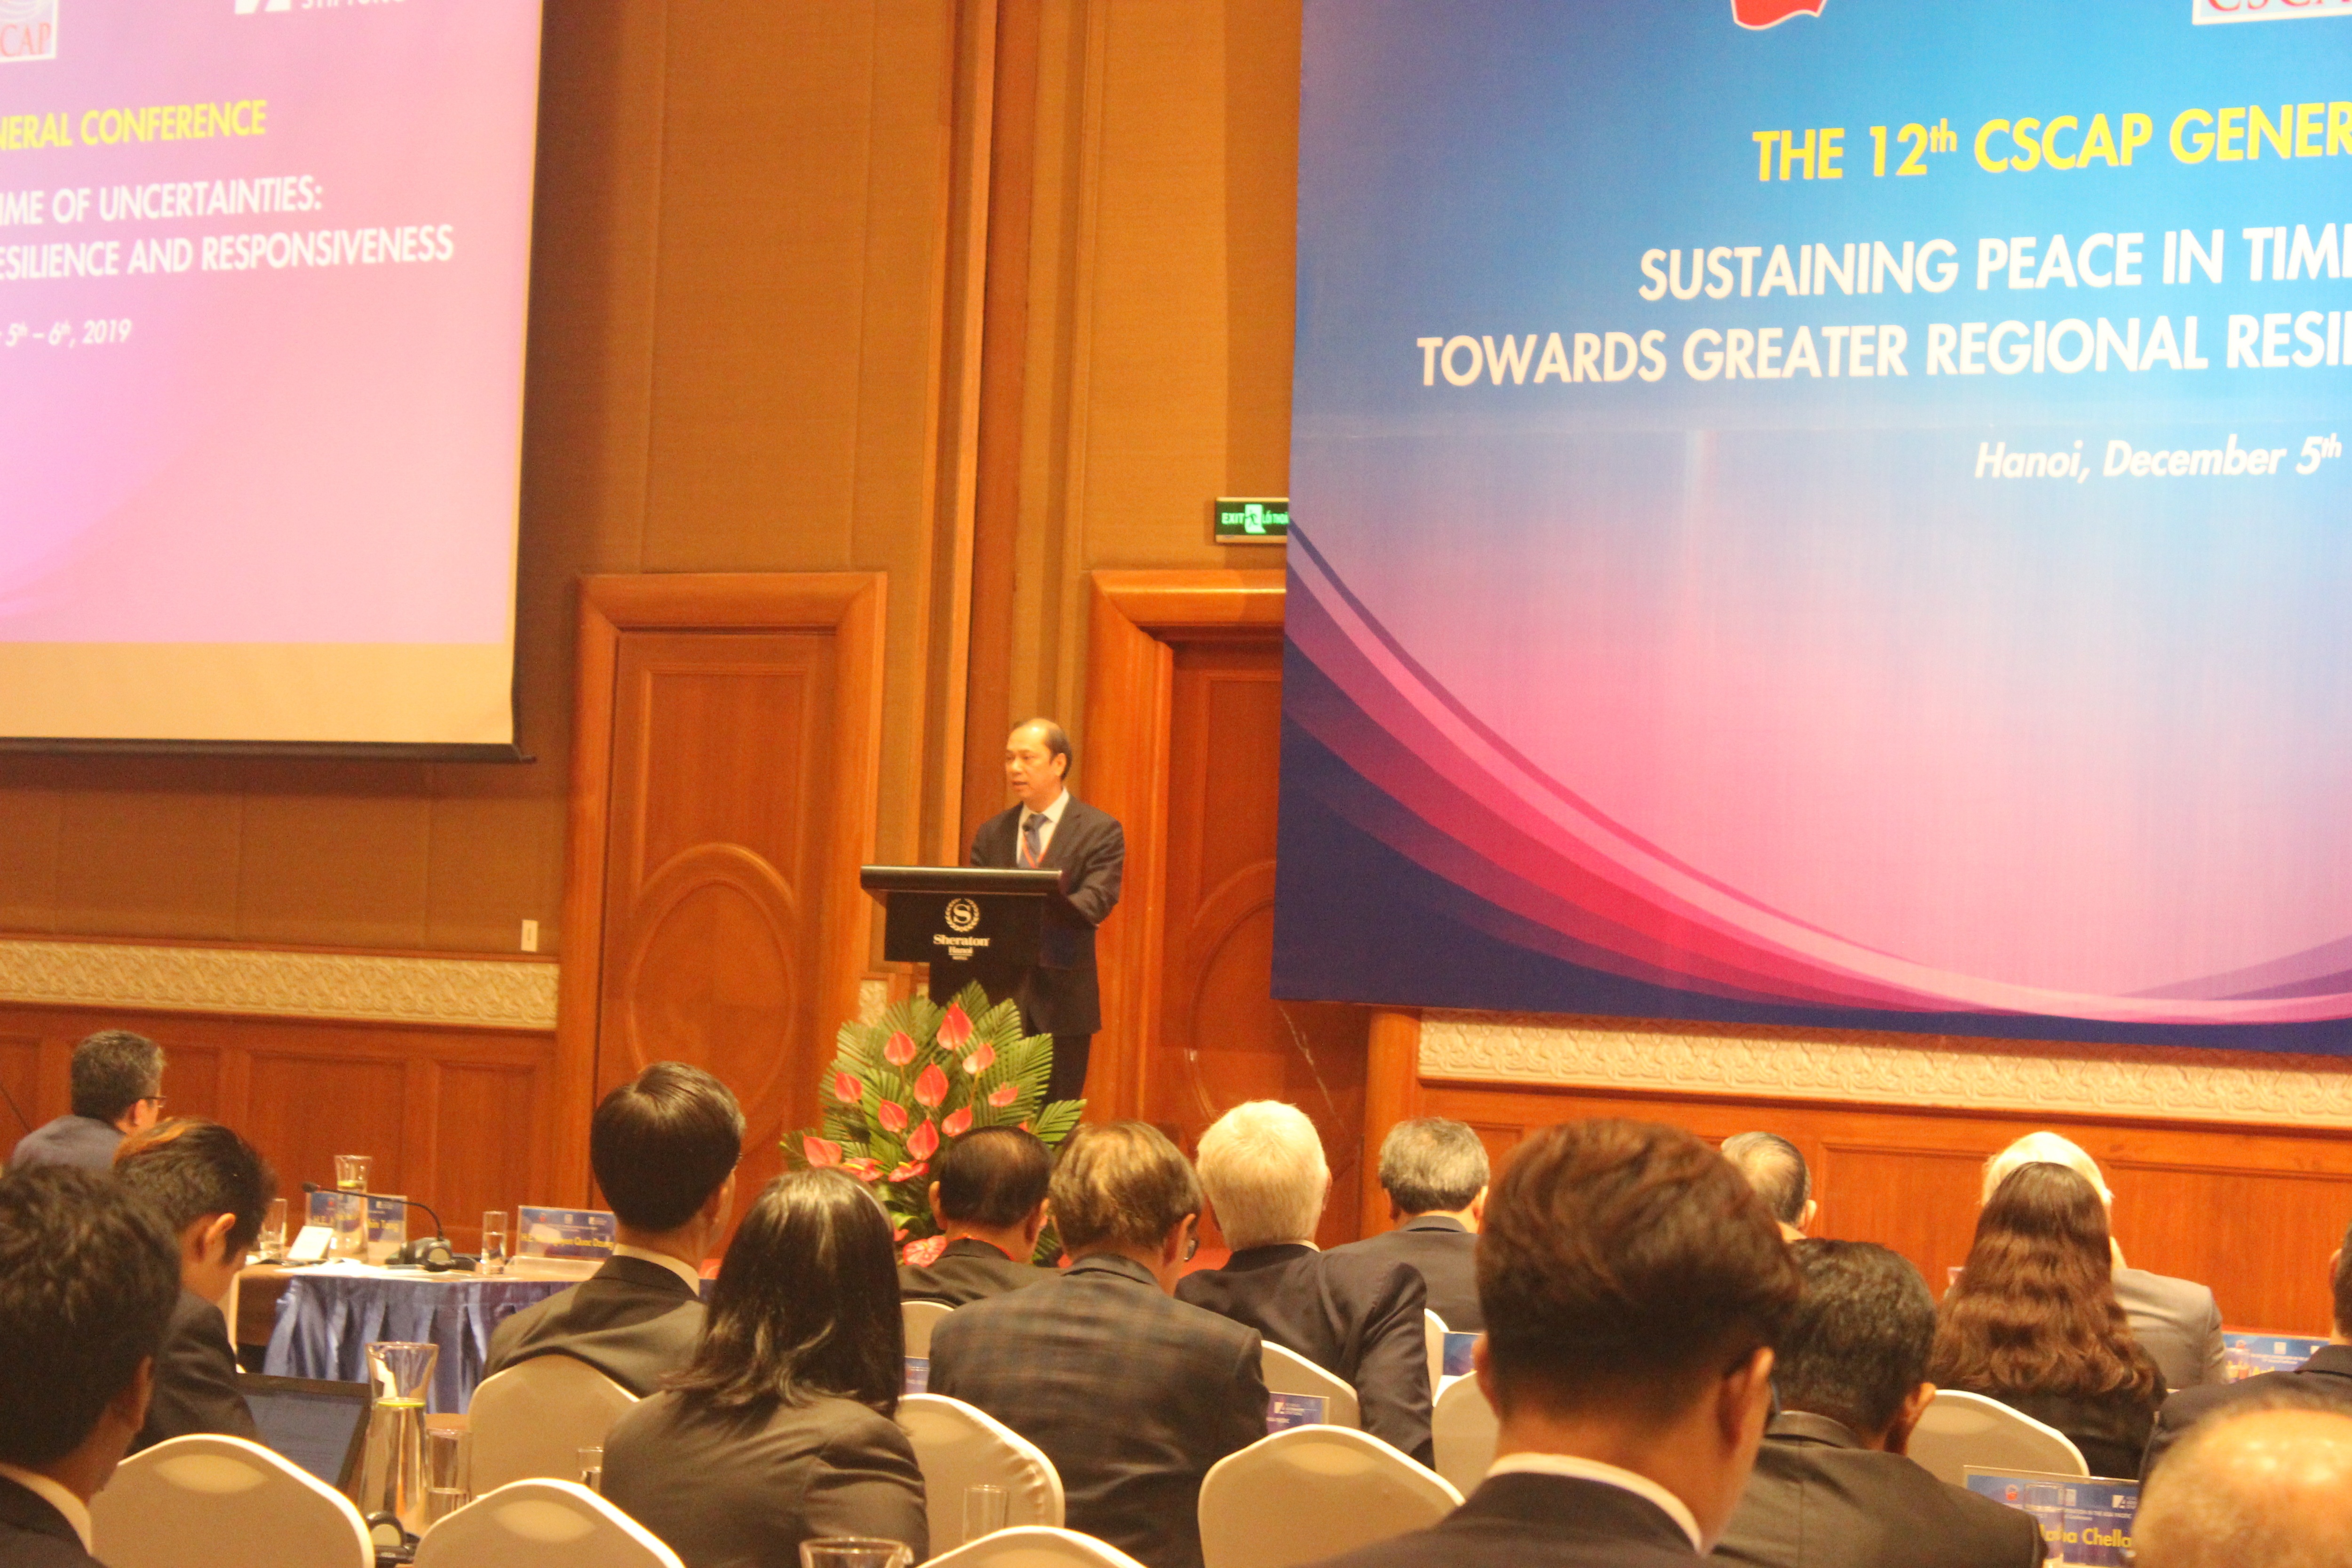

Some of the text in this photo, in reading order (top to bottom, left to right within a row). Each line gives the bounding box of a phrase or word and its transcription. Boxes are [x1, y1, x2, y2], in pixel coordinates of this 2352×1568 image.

[80, 99, 267, 146] CONFERENCE
[1752, 101, 2352, 182] THE 12th CSCAP GENER
[52, 187, 92, 223] OF
[99, 175, 323, 221] UNCERTAINTIES:
[127, 238, 193, 275] AND
[201, 223, 454, 271] RESPONSIVENESS
[1638, 239, 1959, 302] SUSTAINING
[1976, 232, 2143, 290] PEACE
[2163, 228, 2224, 284] IN
[82, 317, 132, 344] 2019
[1416, 329, 1667, 386] TOWARDS
[1682, 324, 1908, 381] GREATER
[1926, 315, 2208, 375] REGIONAL
[1975, 433, 2342, 484] Hanoi, December 5th
[1221, 512, 1245, 525] EXIT
[953, 903, 972, 924] S
[933, 934, 990, 947] Sheraton
